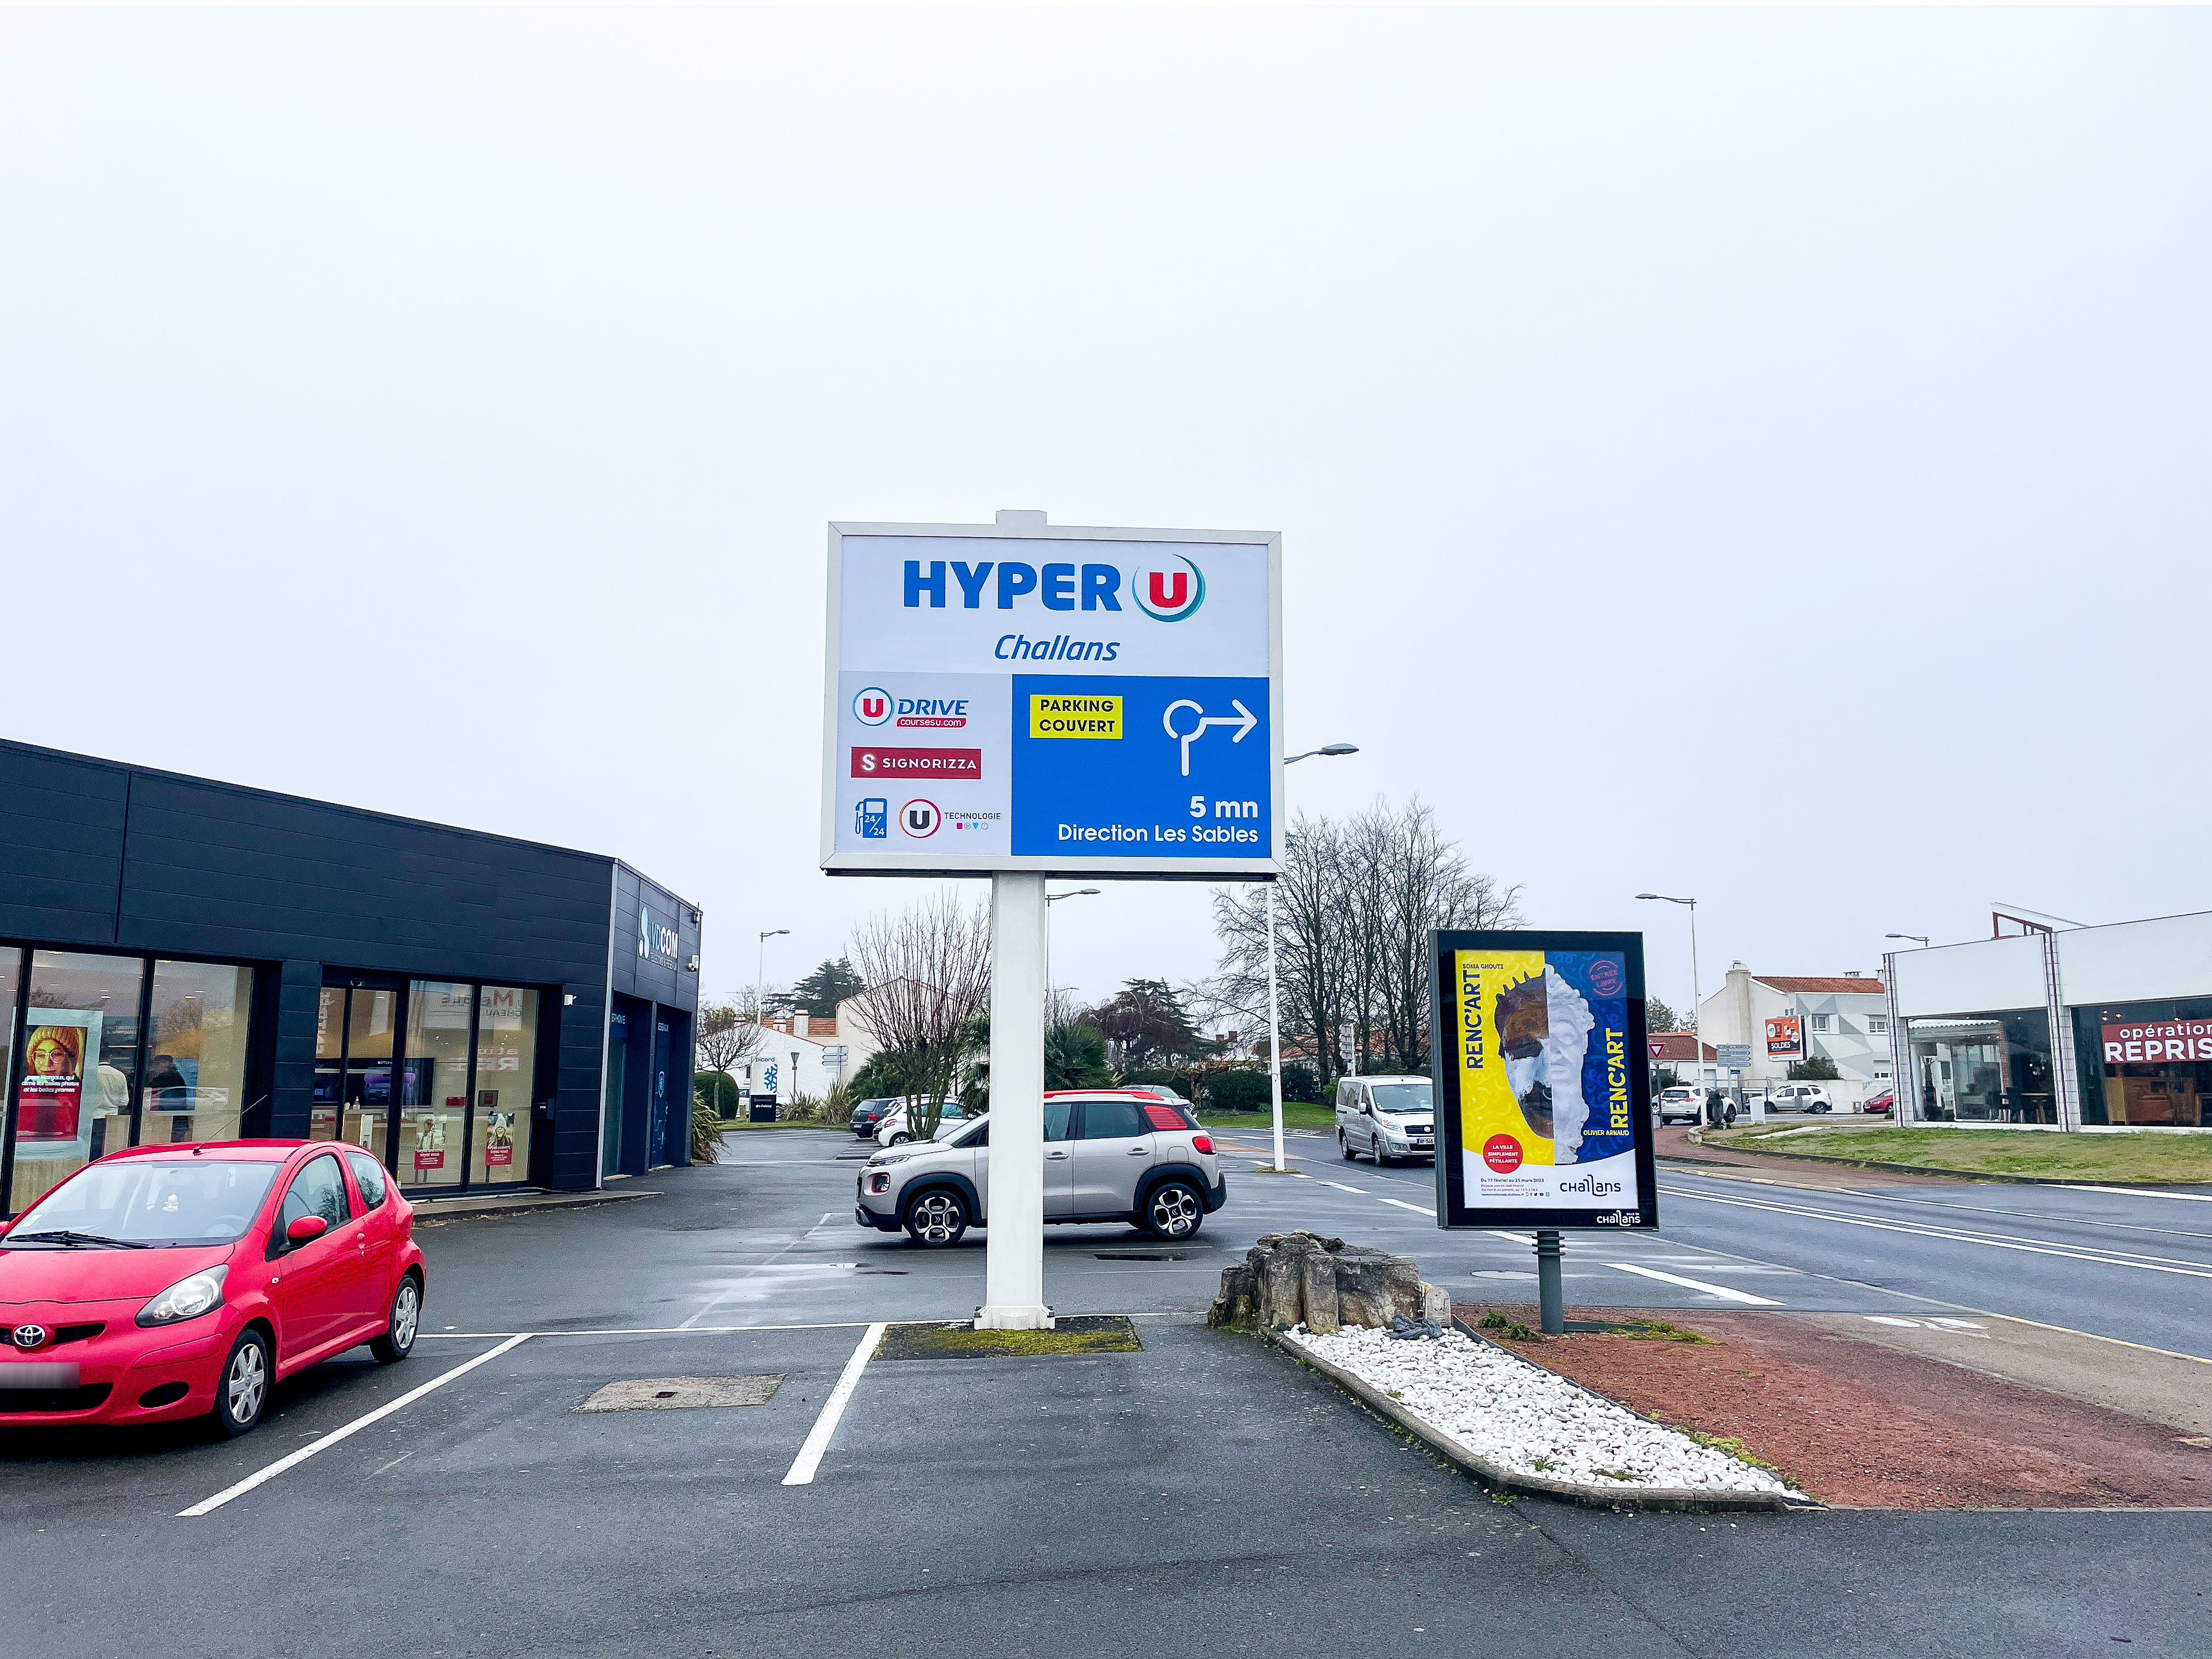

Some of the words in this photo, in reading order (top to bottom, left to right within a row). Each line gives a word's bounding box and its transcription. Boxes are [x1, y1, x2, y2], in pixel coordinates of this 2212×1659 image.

[904, 560, 1122, 612] HYPER
[1149, 572, 1188, 608] U
[994, 634, 1120, 661] Challans
[863, 698, 884, 718] U
[898, 698, 969, 715] DRIVE
[1039, 698, 1115, 713] PARKING
[1039, 718, 1115, 733] COUVERT
[882, 758, 977, 769] SIGNORIZZA
[1189, 795, 1207, 819] 5
[1215, 800, 1259, 819] mn
[909, 810, 930, 830] U
[944, 812, 1002, 820] TECHNOLOGIE
[1058, 823, 1148, 842] Direction
[1155, 825, 1187, 843] Les
[1191, 825, 1259, 843] Sables
[651, 922, 679, 959] VDCOM
[1463, 969, 1483, 1069] RENC'ART
[1605, 1027, 1629, 1128] RENC'ART
